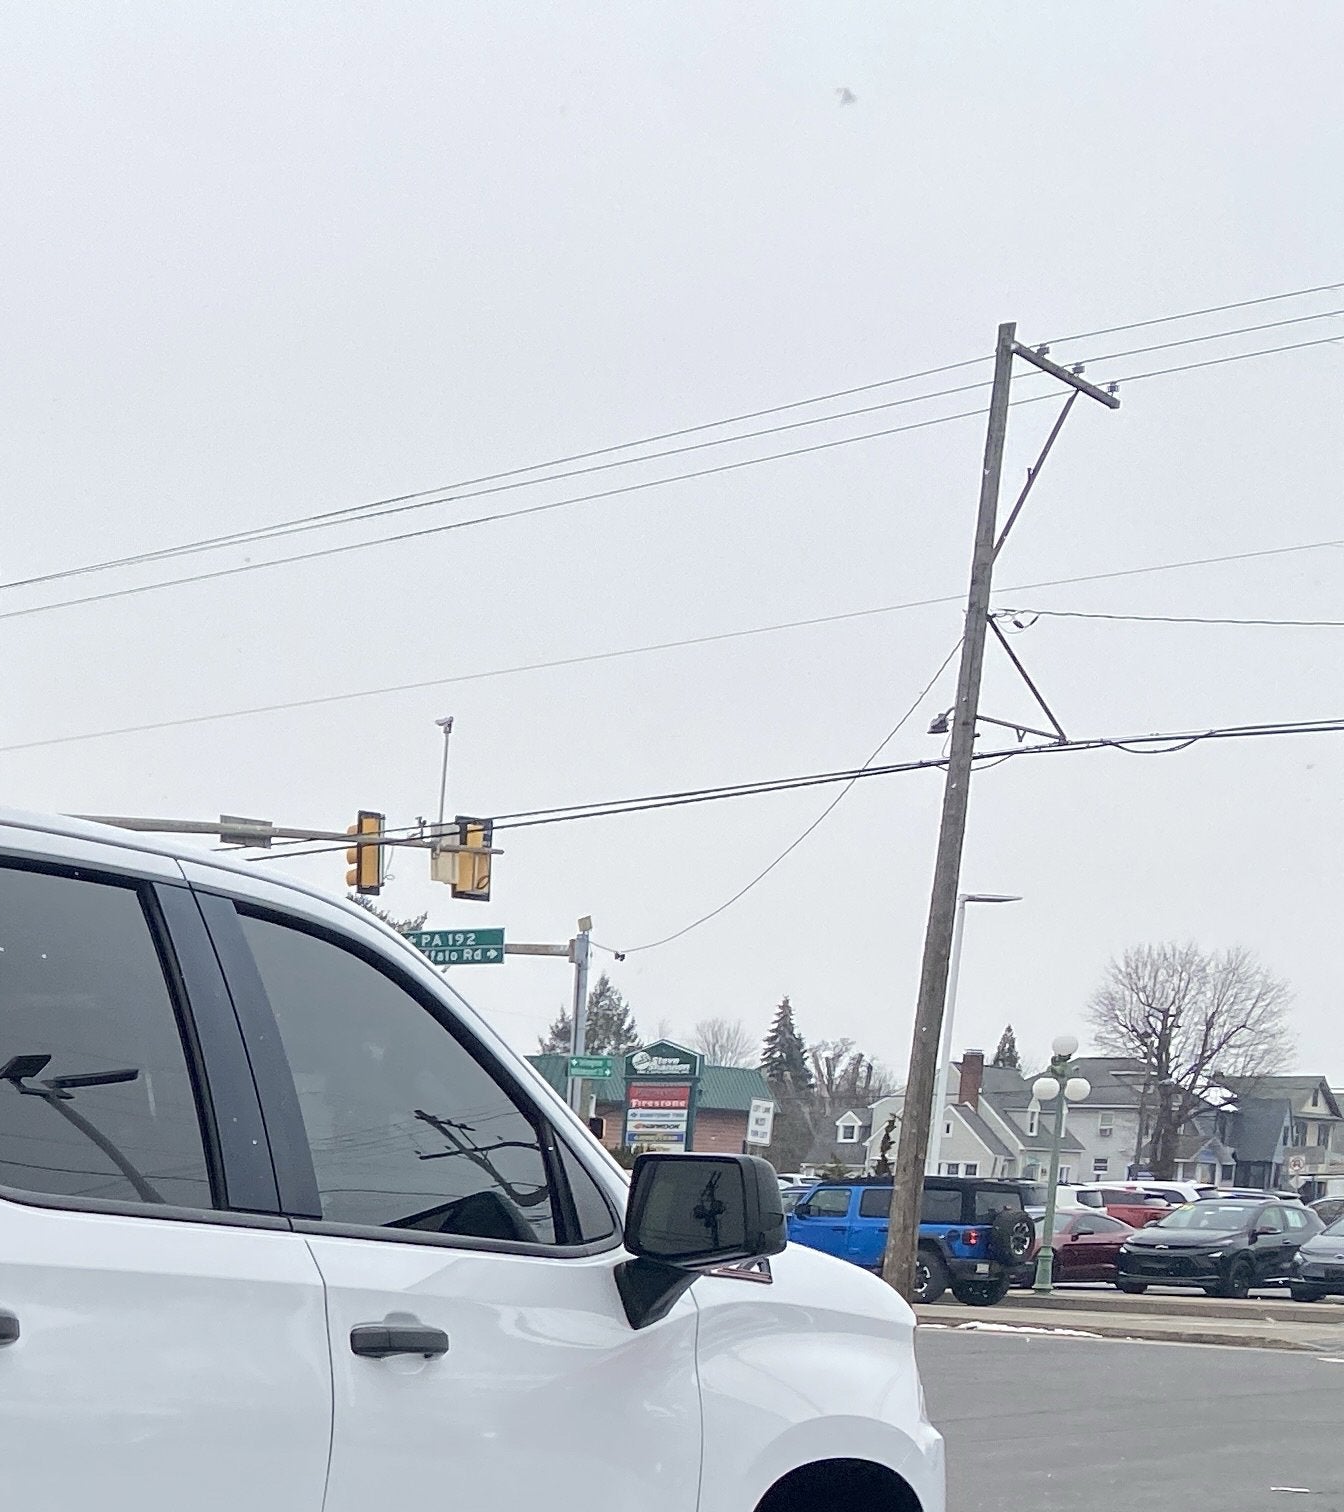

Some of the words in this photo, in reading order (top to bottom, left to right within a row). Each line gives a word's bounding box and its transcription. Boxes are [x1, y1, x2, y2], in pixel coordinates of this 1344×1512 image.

[421, 934, 442, 947] PA
[447, 932, 476, 946] 192
[463, 948, 482, 960] Rd
[631, 1099, 686, 1109] Firestone
